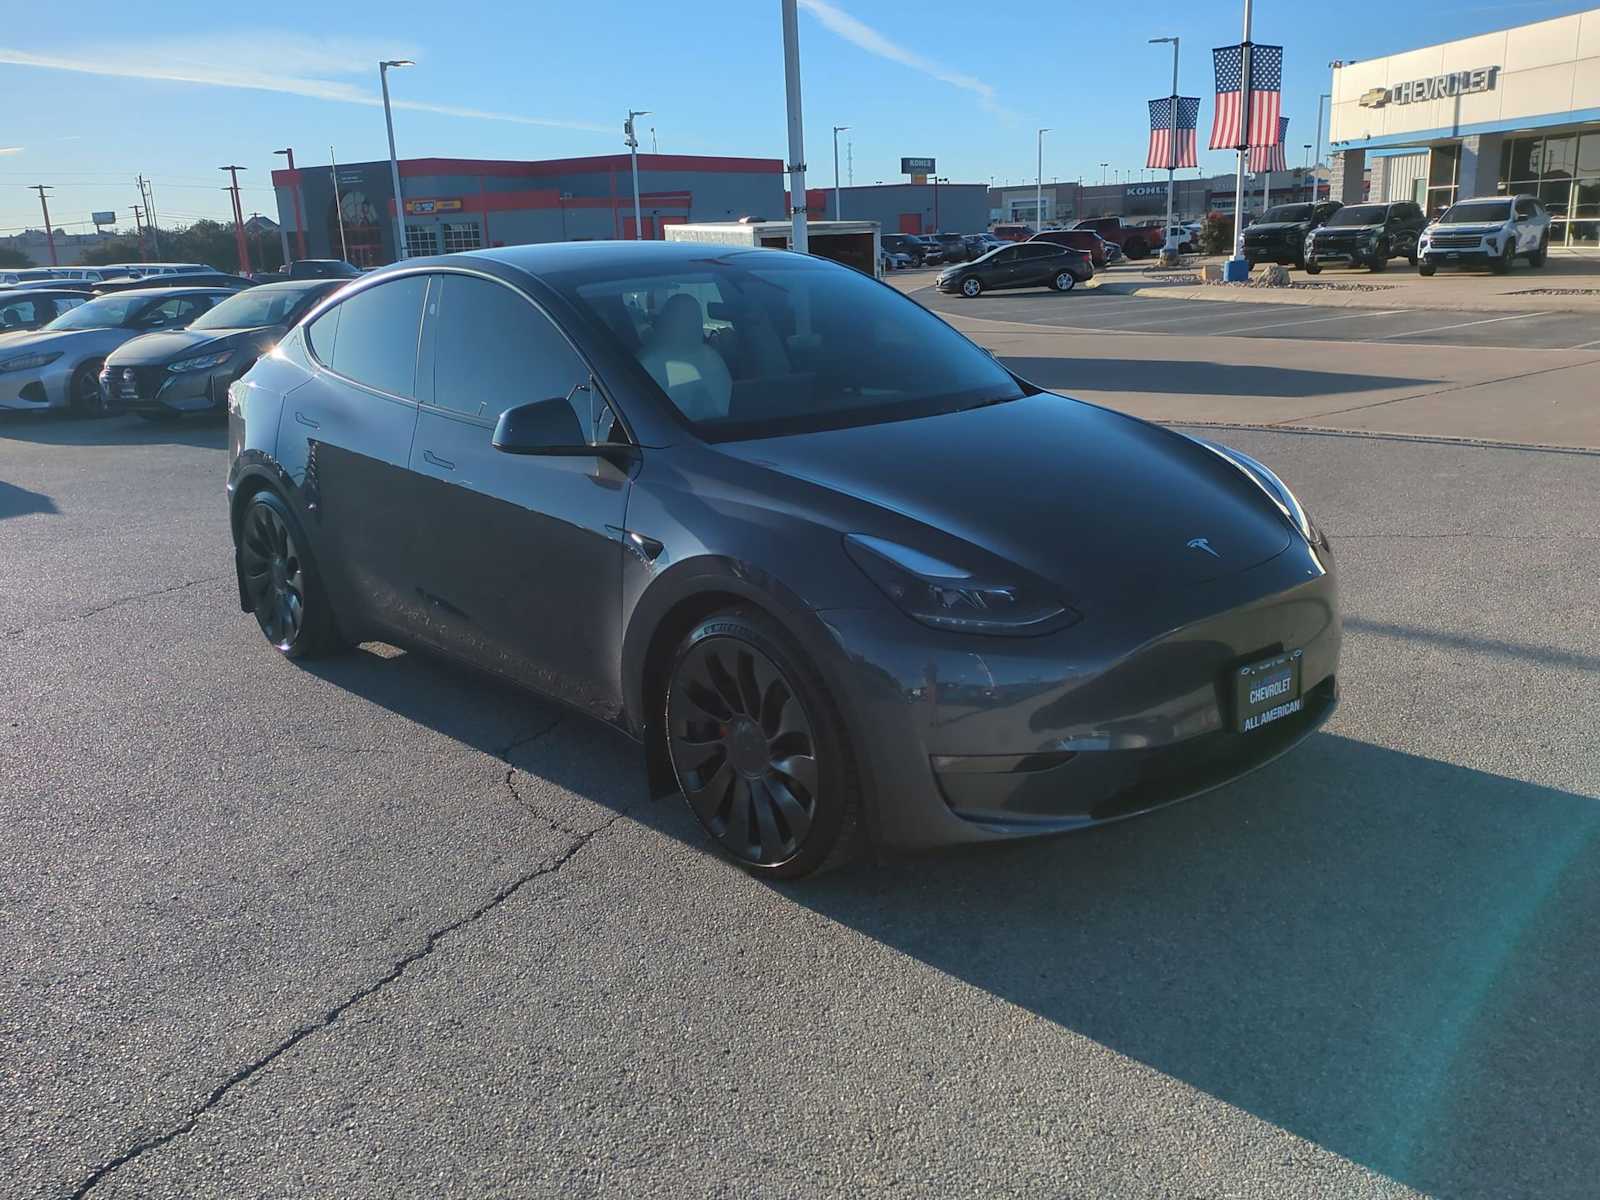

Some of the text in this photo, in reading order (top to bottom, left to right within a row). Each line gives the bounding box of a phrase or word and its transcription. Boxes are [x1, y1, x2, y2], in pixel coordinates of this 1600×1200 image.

[1391, 65, 1501, 105] CHEVROLET
[1249, 677, 1291, 704] CHEVROLET
[1244, 699, 1300, 732] ALL AMERICAN
